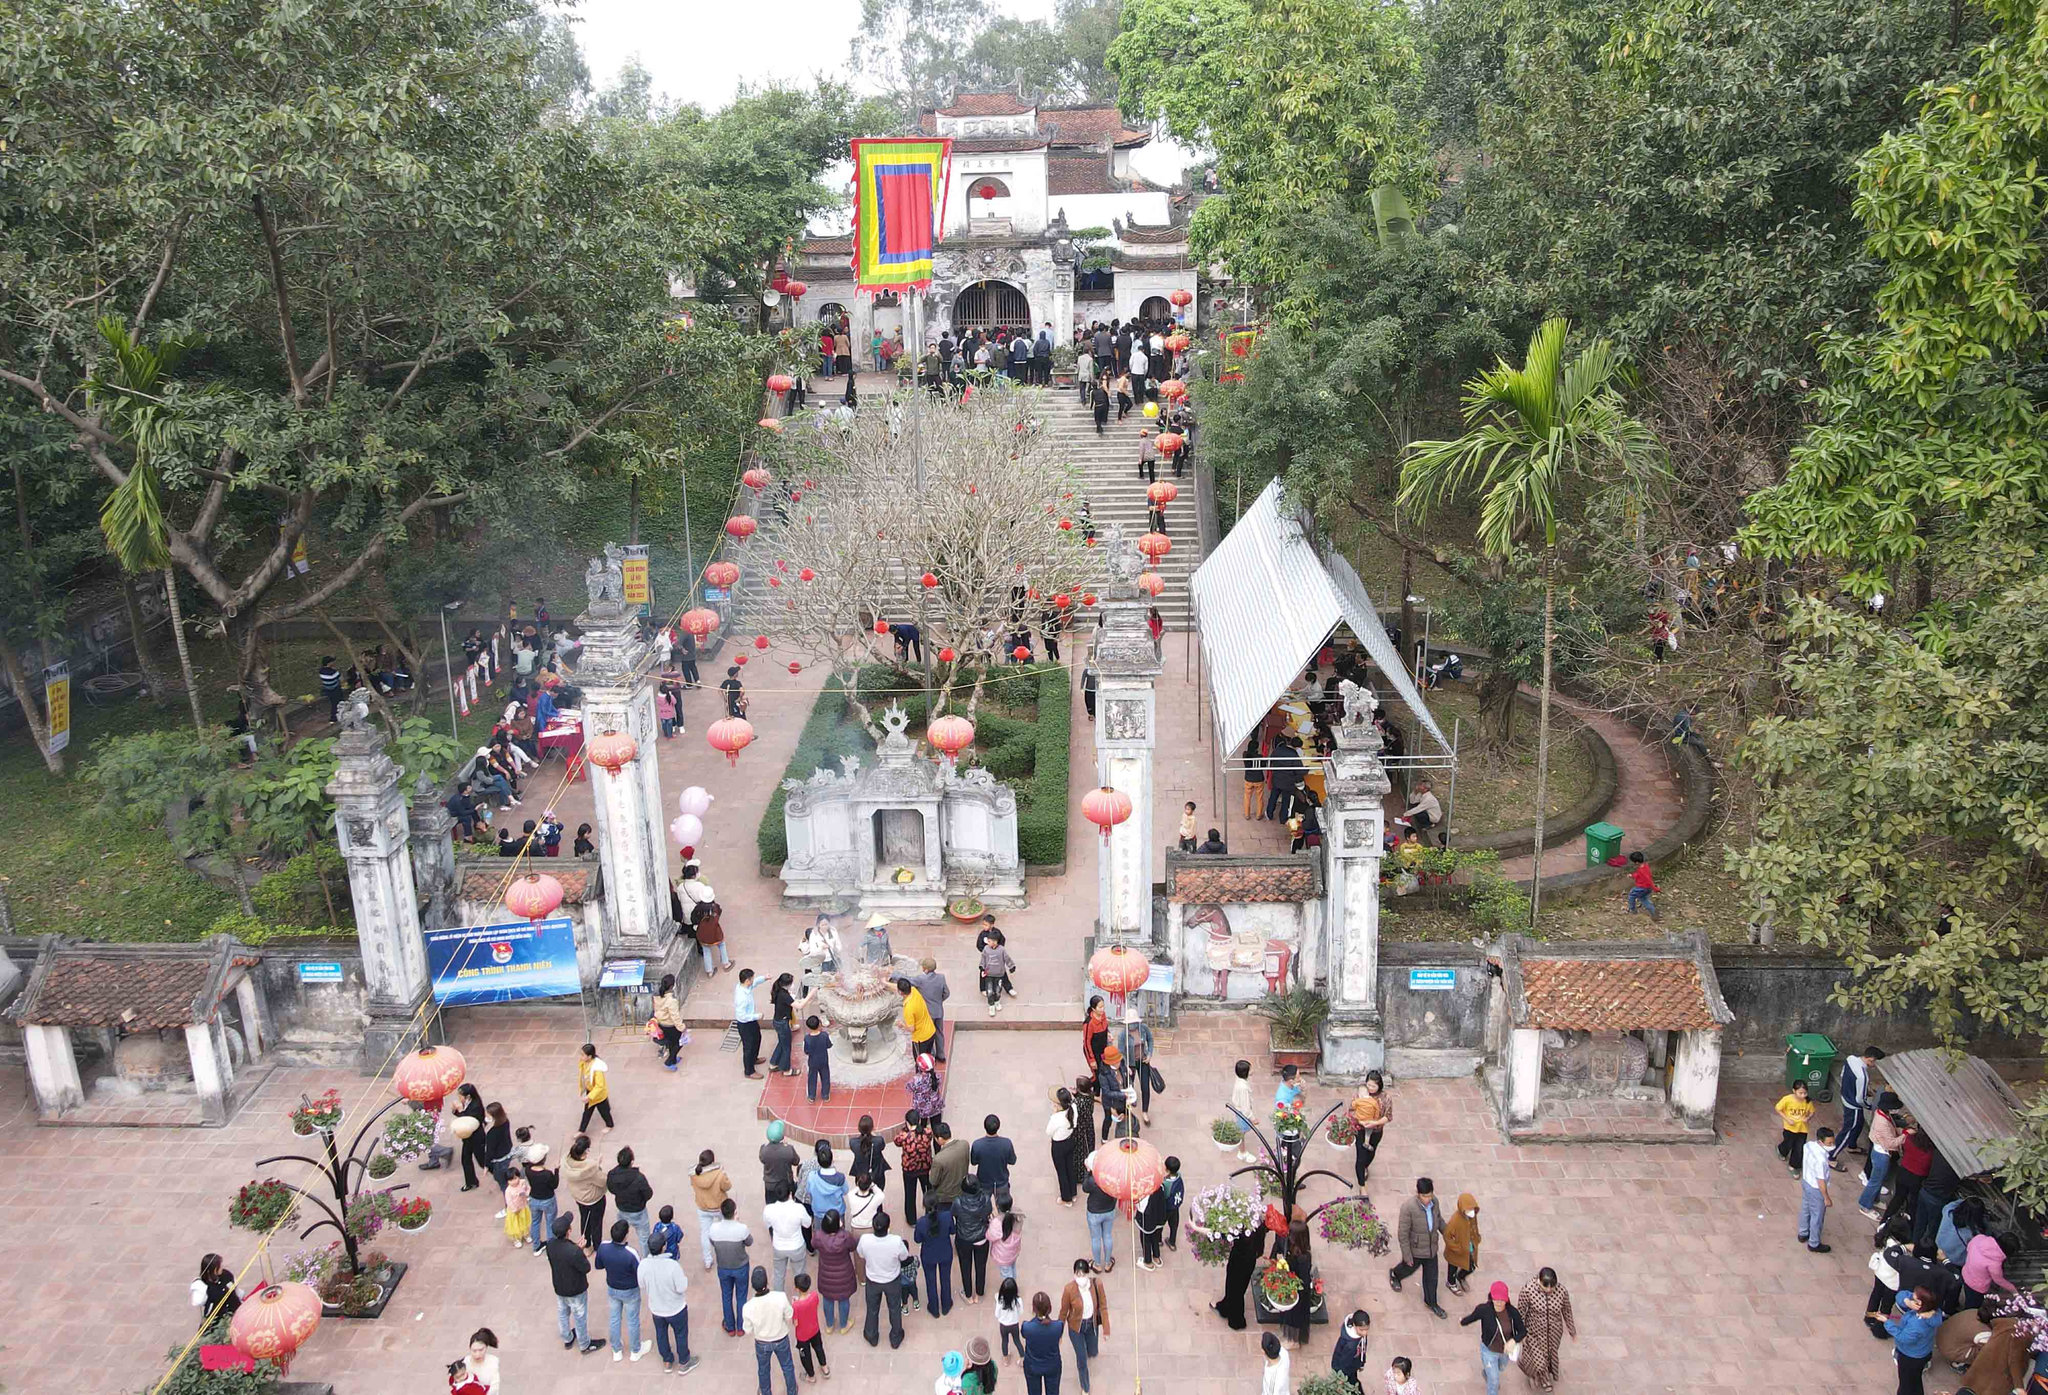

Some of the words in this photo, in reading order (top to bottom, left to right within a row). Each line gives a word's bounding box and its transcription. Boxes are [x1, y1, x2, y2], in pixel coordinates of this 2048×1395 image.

[458, 967, 479, 978] CÔNG
[481, 965, 505, 976] TRÌNH
[507, 962, 532, 973] THANH
